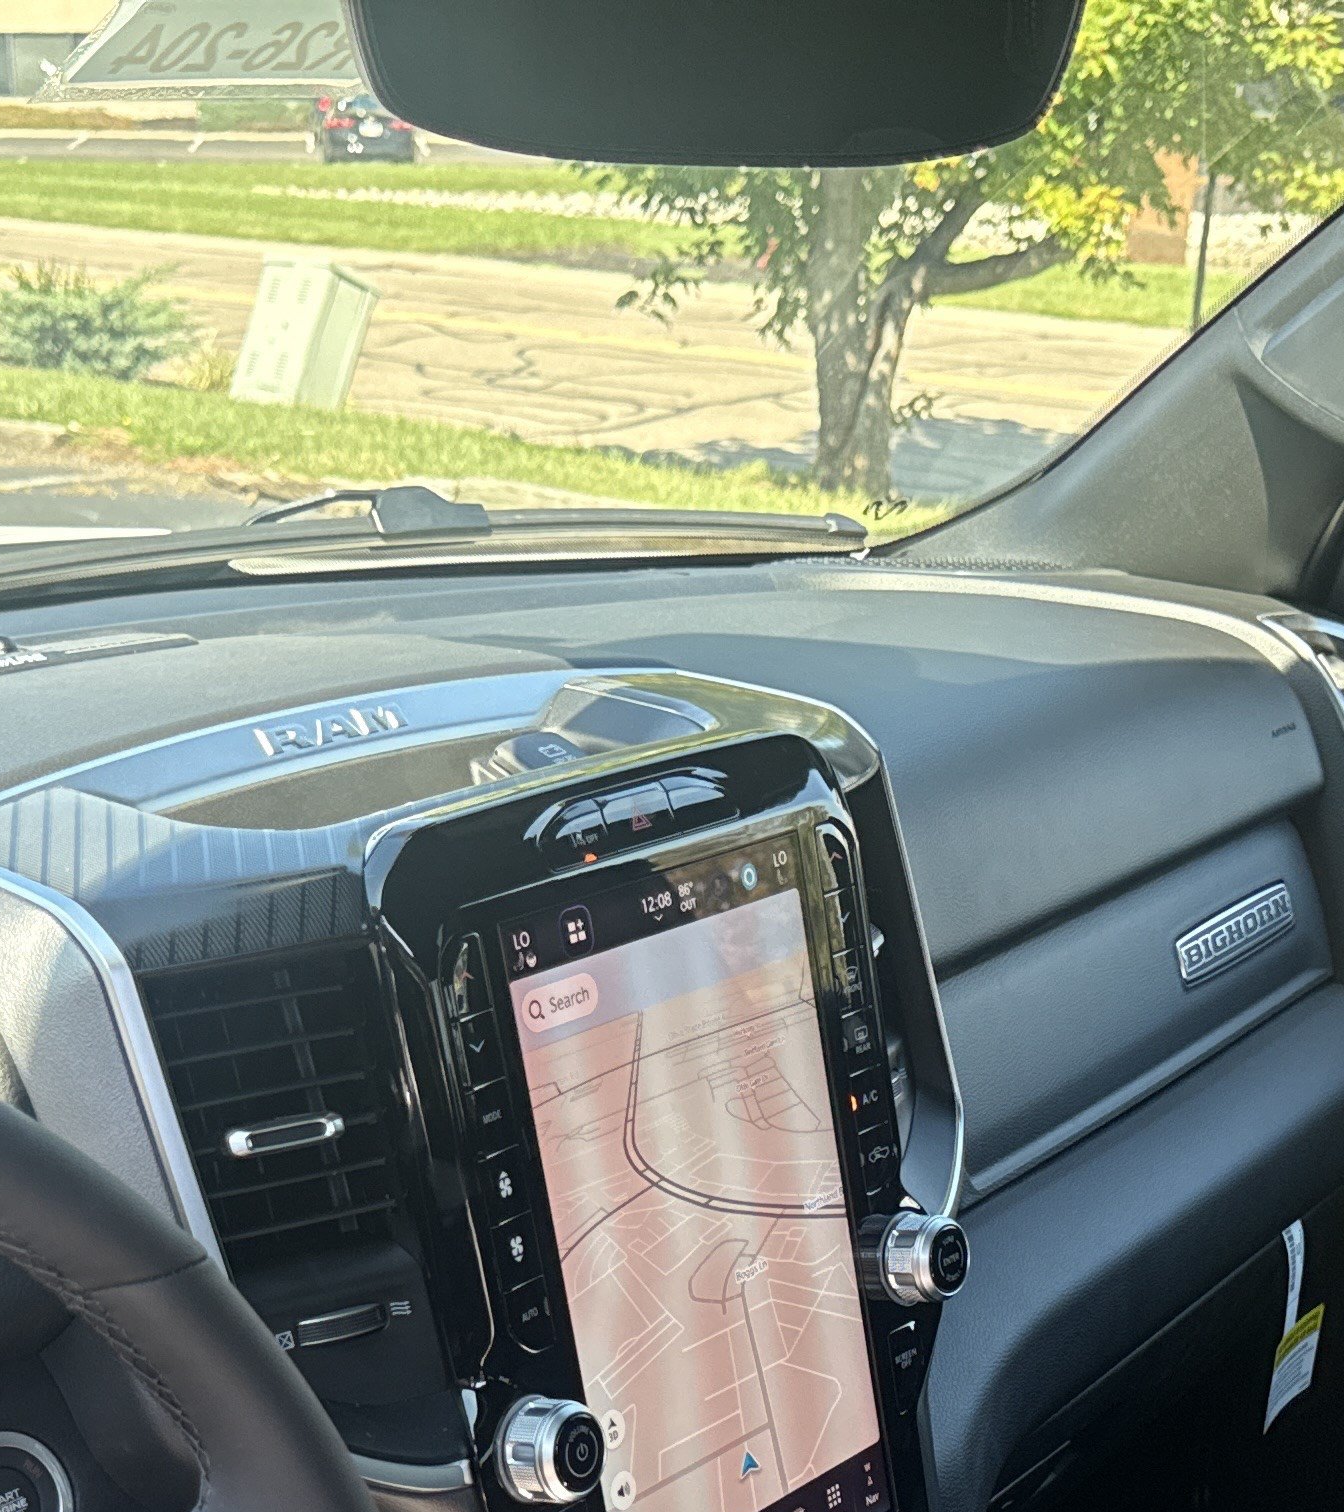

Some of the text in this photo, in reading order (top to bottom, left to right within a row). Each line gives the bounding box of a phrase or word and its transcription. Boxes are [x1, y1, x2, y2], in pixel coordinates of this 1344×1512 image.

[254, 700, 408, 758] RAM
[772, 850, 787, 868] LO
[641, 891, 673, 914] 12:08
[680, 898, 698, 912] OUT
[512, 931, 531, 950] LO
[1181, 892, 1291, 971] BIGHORN
[548, 986, 591, 1014] Search
[862, 1089, 879, 1106] A/C
[482, 1109, 503, 1125] MODE
[735, 1261, 769, 1282] Boggs Ln
[522, 1307, 539, 1323] AUTO
[608, 1430, 619, 1443] 3D
[865, 1492, 880, 1506] Nav
